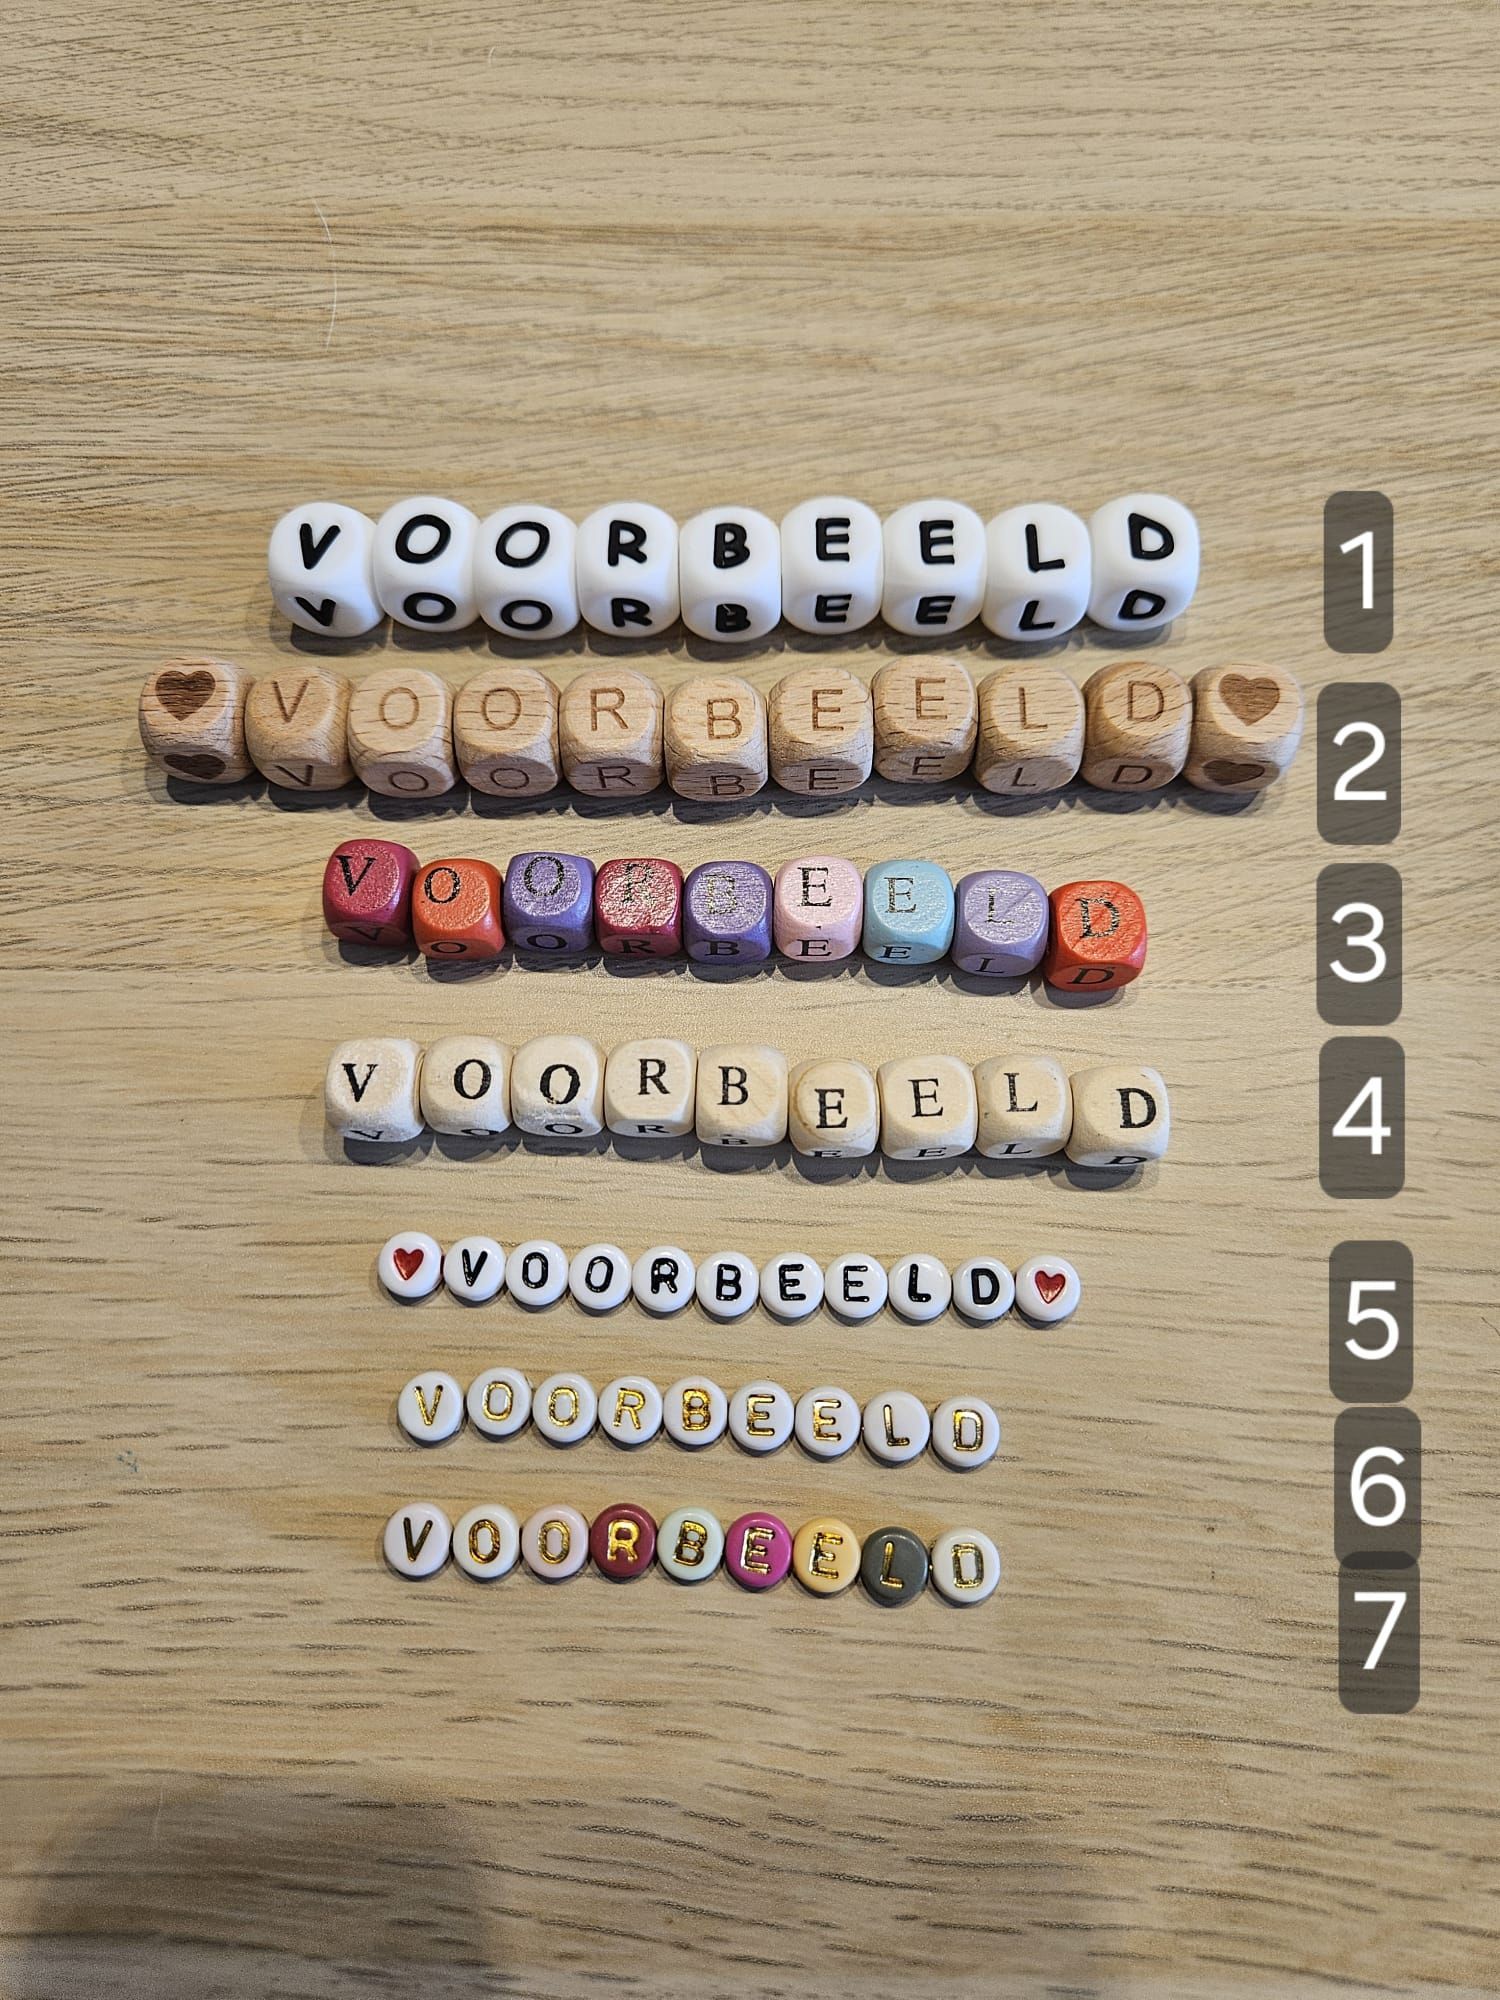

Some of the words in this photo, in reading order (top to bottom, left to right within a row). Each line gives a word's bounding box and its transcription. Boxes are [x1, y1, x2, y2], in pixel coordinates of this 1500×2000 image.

[299, 512, 1175, 574] VOORBEELD
[294, 589, 1167, 633] VOORBEELD
[272, 677, 1165, 740] VOORBEELD
[274, 755, 1153, 797] VOORBEELD
[347, 926, 1115, 986] VOORBEELD
[341, 1057, 1157, 1129] VOORBEELD
[462, 1247, 1001, 1305] VOORBEELD
[414, 1380, 985, 1452] VOORBEELD
[403, 1516, 985, 1590] VOORBEELD
